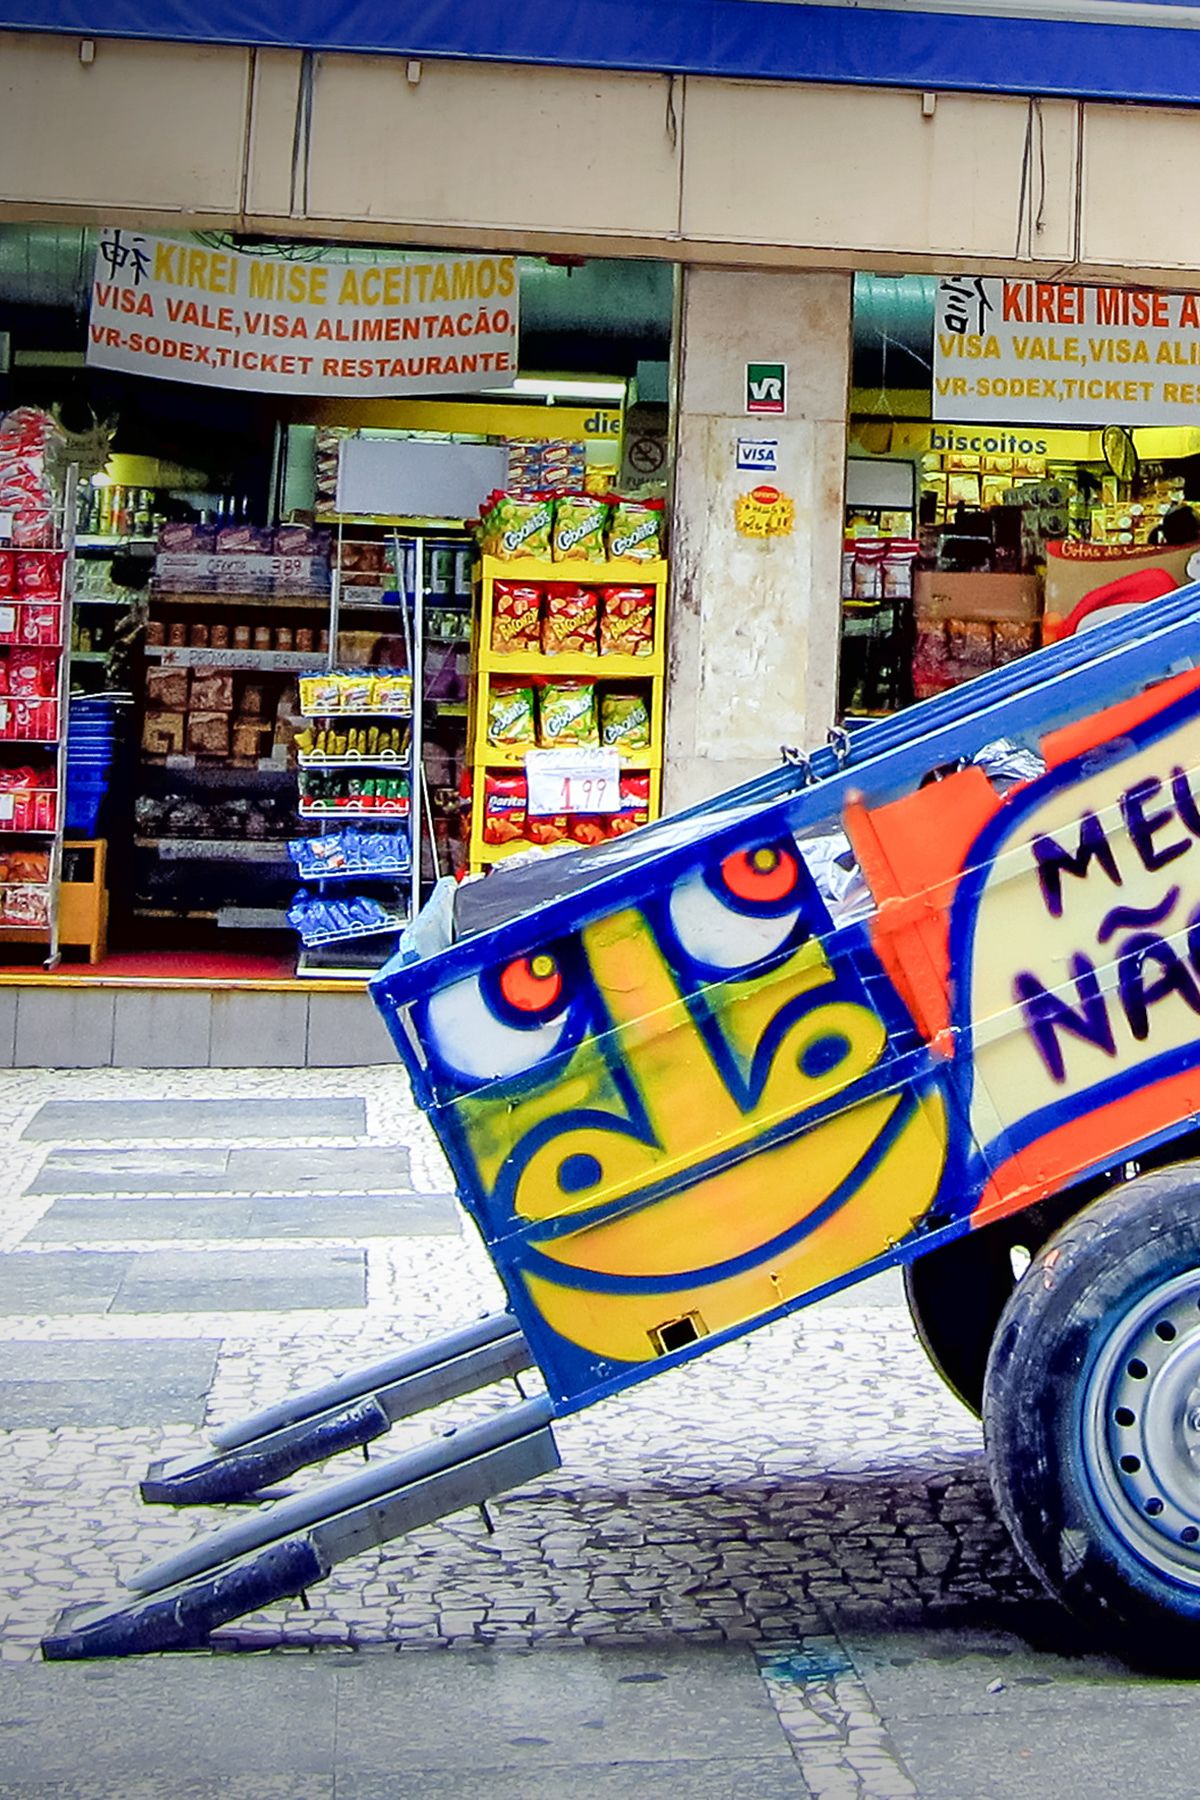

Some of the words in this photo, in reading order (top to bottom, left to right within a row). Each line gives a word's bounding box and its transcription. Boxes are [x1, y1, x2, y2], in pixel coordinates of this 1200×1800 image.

[154, 241, 239, 295] KIREI
[249, 260, 329, 306] MISE
[337, 257, 516, 306] ACEITAMOS
[95, 281, 155, 318] VISA
[1003, 281, 1086, 324] KIREI
[1096, 287, 1170, 327] MISE
[937, 333, 1001, 359] VISA
[322, 352, 517, 378] RESTAURANTE.
[750, 377, 782, 400] VR
[930, 428, 1048, 454] biscoitos
[743, 448, 776, 462] VISA
